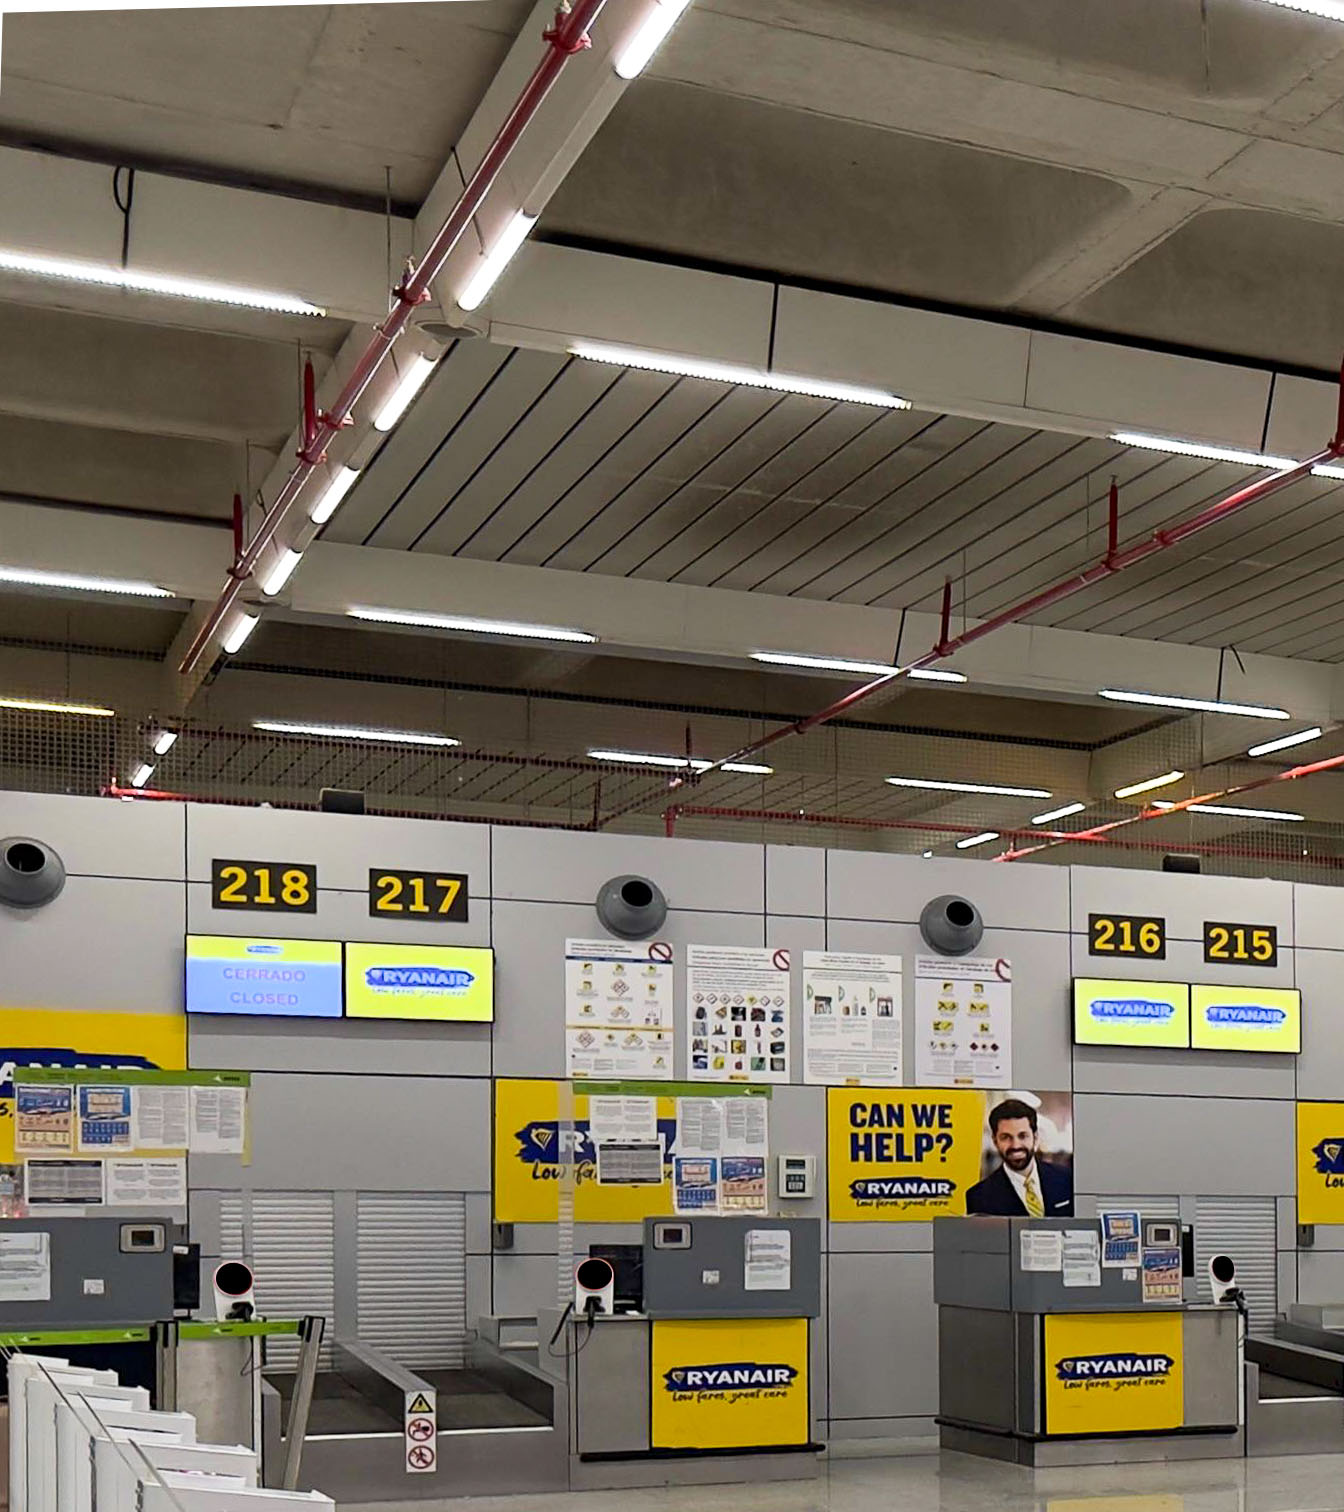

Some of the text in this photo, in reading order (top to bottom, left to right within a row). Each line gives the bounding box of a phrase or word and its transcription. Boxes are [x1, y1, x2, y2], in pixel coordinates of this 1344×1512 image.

[219, 866, 310, 905] 218
[376, 876, 461, 912] 217
[1094, 919, 1160, 954] 216
[1209, 927, 1273, 961] 215
[223, 968, 305, 983] CERRADO
[383, 970, 469, 986] RYANAIR
[230, 991, 298, 1005] CLOSED
[1104, 1002, 1171, 1017] RYANAIR
[1219, 1009, 1283, 1024] RYANAIR
[850, 1102, 953, 1128] CAN WE
[850, 1132, 953, 1163] HELP?
[867, 1182, 950, 1195] RYANAIR
[1076, 1358, 1167, 1375] RYANAIR
[687, 1368, 790, 1386] RYANAIR
